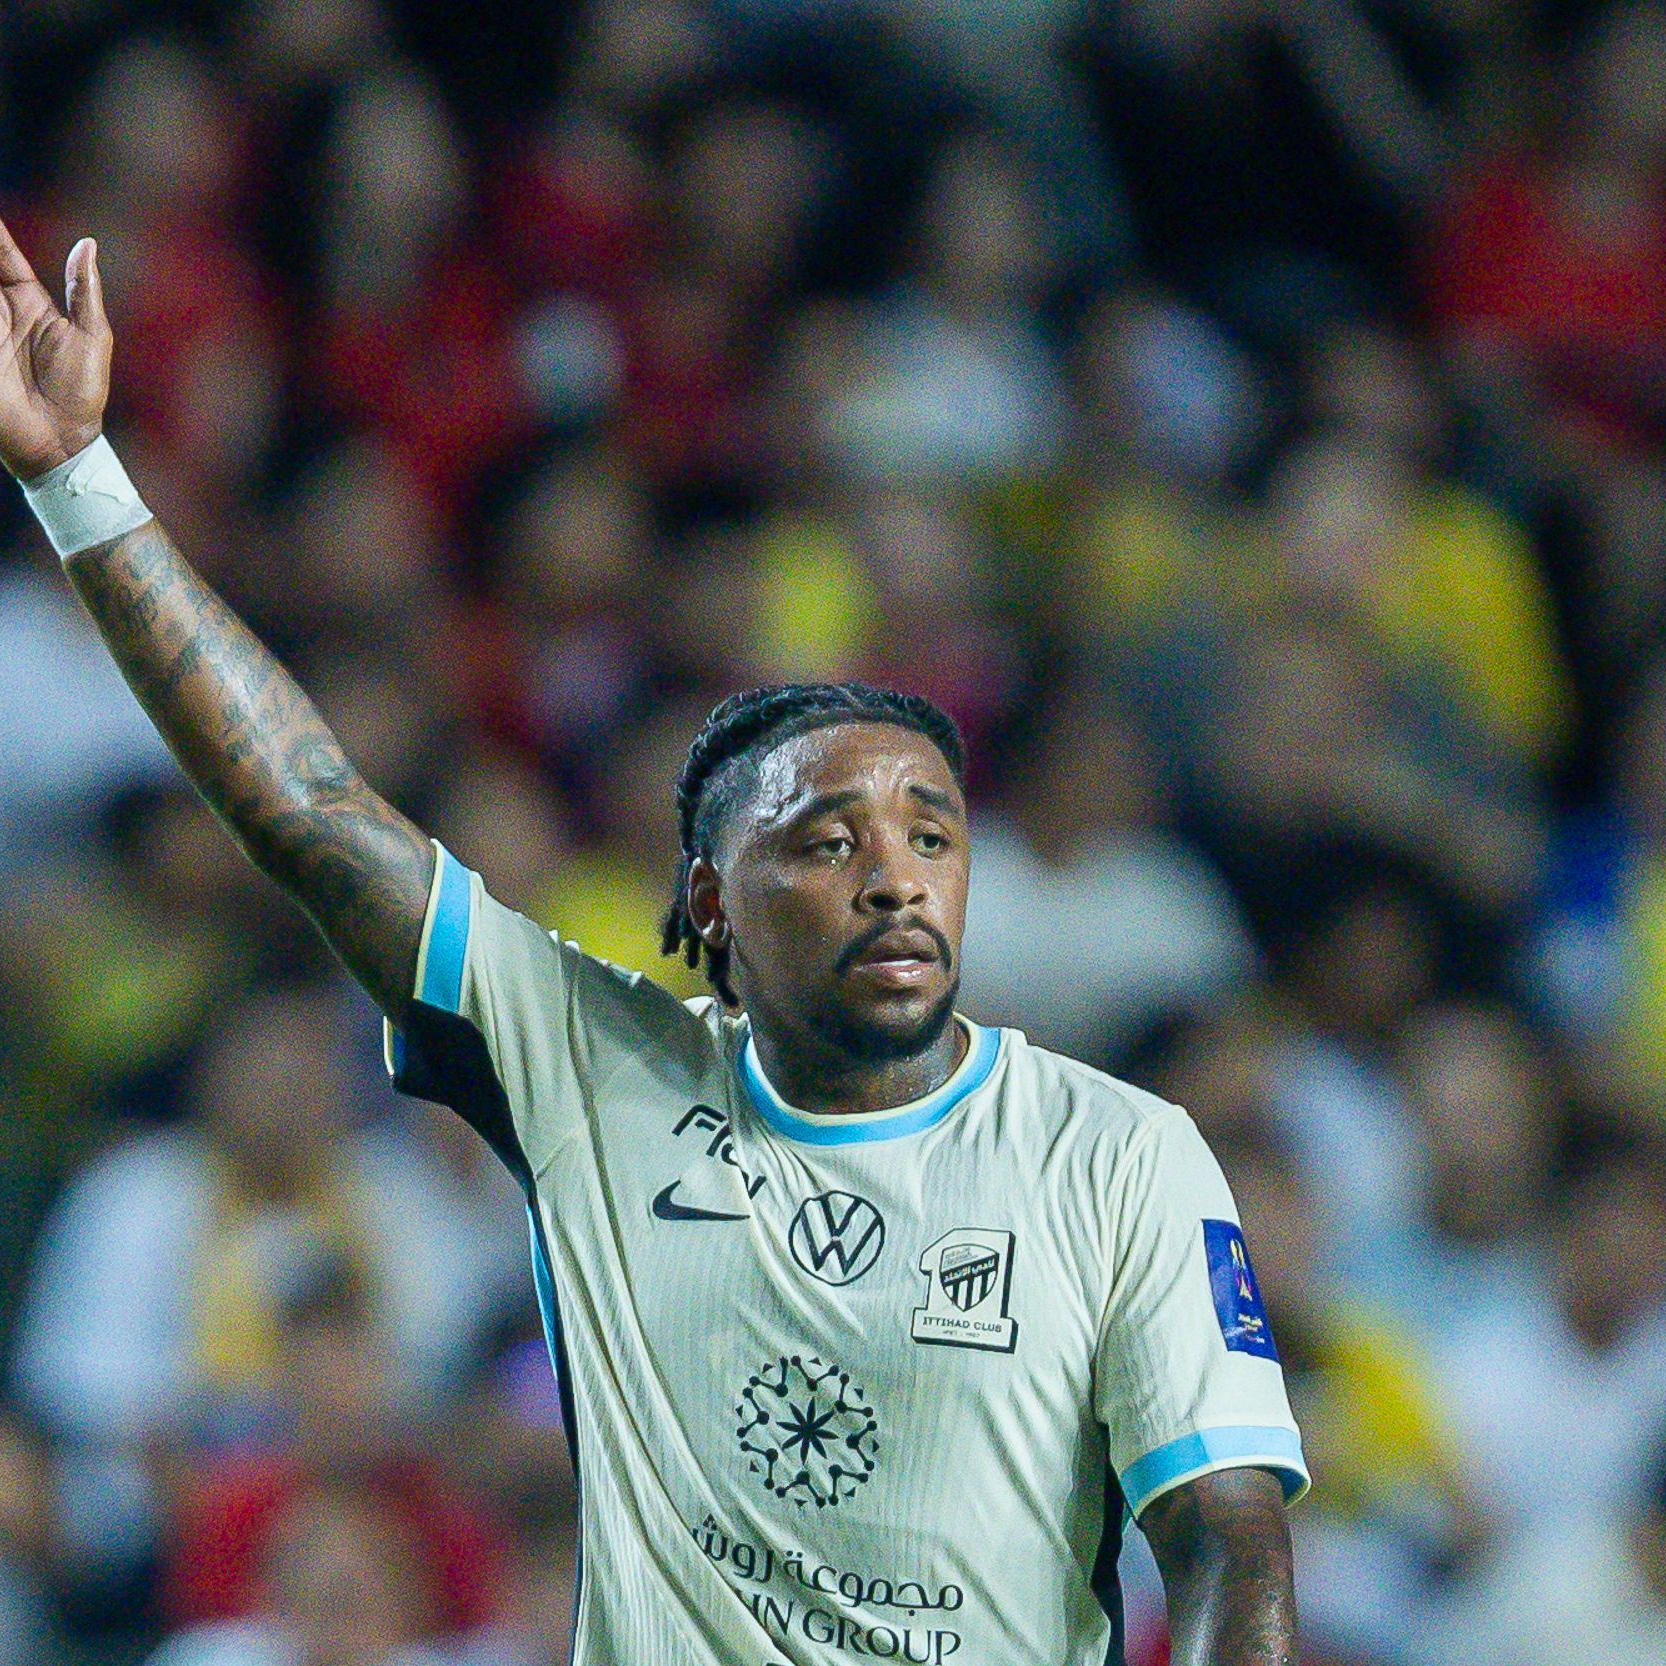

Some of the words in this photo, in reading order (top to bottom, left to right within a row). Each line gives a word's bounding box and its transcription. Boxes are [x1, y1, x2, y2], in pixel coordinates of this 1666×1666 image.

[923, 1316, 970, 1329] ITTIHAD
[973, 1321, 1002, 1333] CLUB
[783, 1550, 964, 1617] مجموعة
[802, 1608, 961, 1666] GROUP
